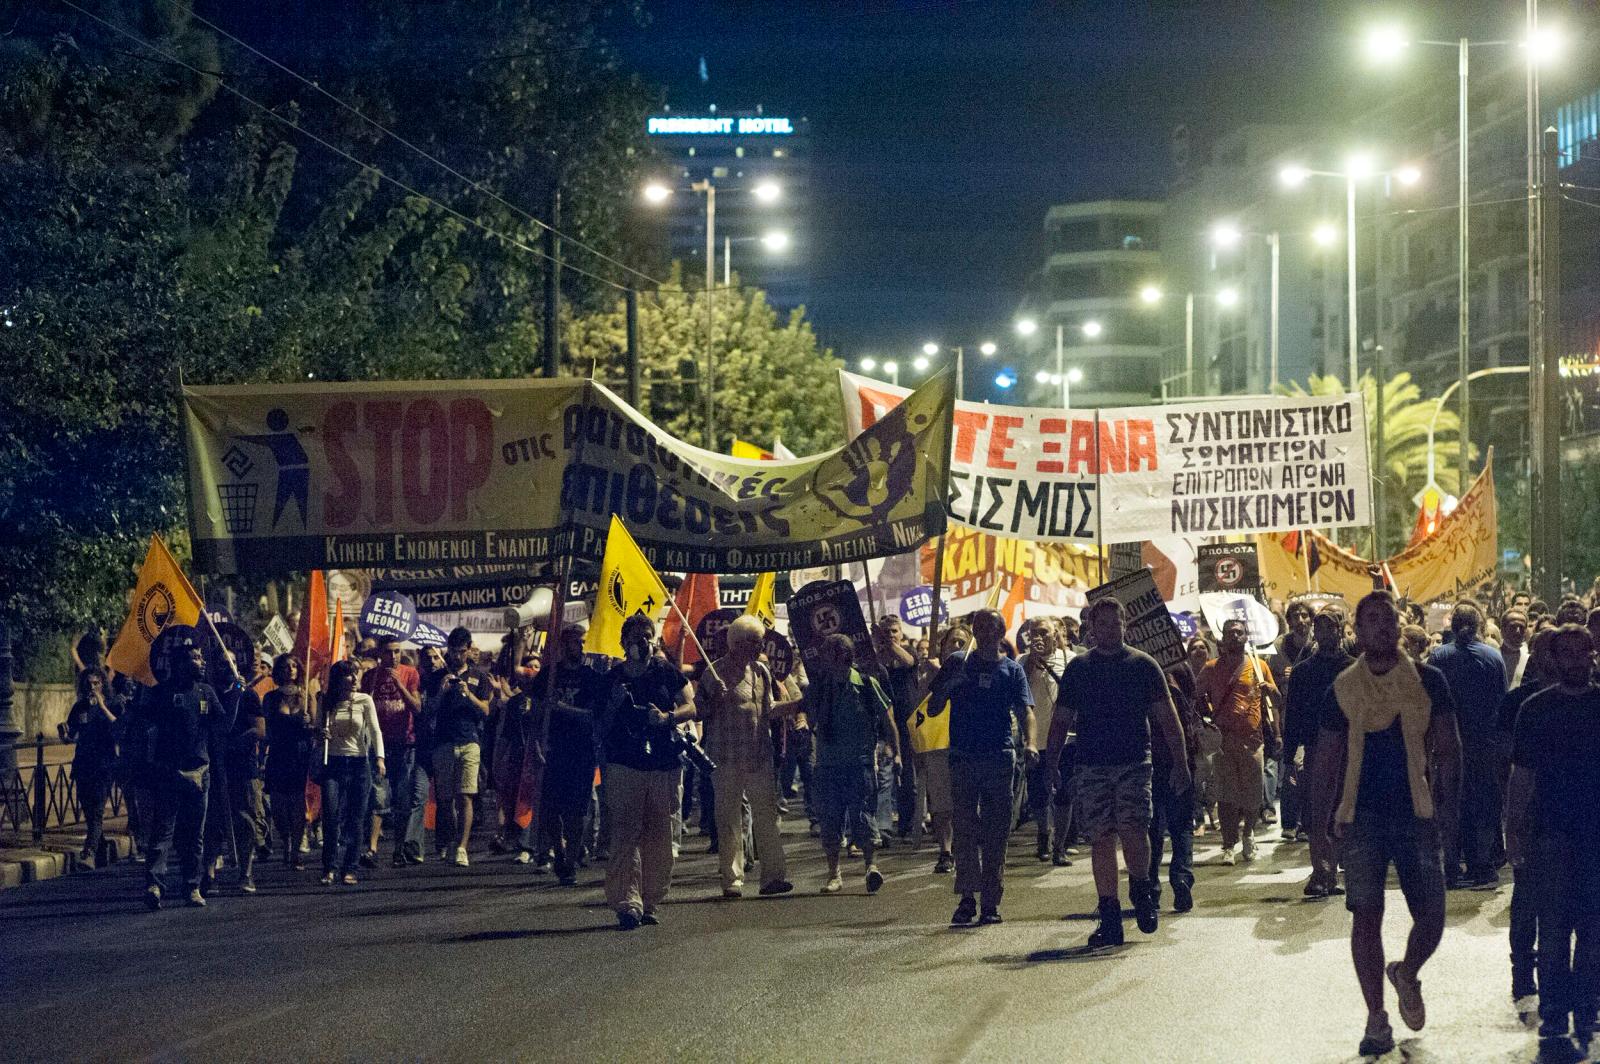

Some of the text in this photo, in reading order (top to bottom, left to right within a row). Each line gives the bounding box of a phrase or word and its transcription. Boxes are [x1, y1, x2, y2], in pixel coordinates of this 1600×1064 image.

[738, 117, 793, 134] HOTEL
[1166, 402, 1352, 443] ΣΥΝΤΟΝΙΣΤΙΚΟ
[502, 433, 556, 466] στις
[953, 409, 1158, 474] ΤΕ ΞΑΝΑ
[1182, 438, 1327, 468] ΣΩΜΑΤΕΙΩΝ
[323, 398, 494, 528] STOP
[1172, 462, 1346, 496] ΕΠΙΤΡΟΠΩΝ ΑΓΩΝΑ
[947, 469, 1096, 539] ΣΙΣΜΟΣ
[1171, 488, 1356, 534] ΝΟΣΟΚΟΜΕΙΩΝ
[941, 532, 986, 582] ΚΑΙ
[374, 597, 403, 617] ΕΞΩ
[407, 587, 497, 608] ΑΚΙΣΤΑΝΙΚΗ
[366, 612, 411, 634] ΝΕΟΝΑΖΙ
